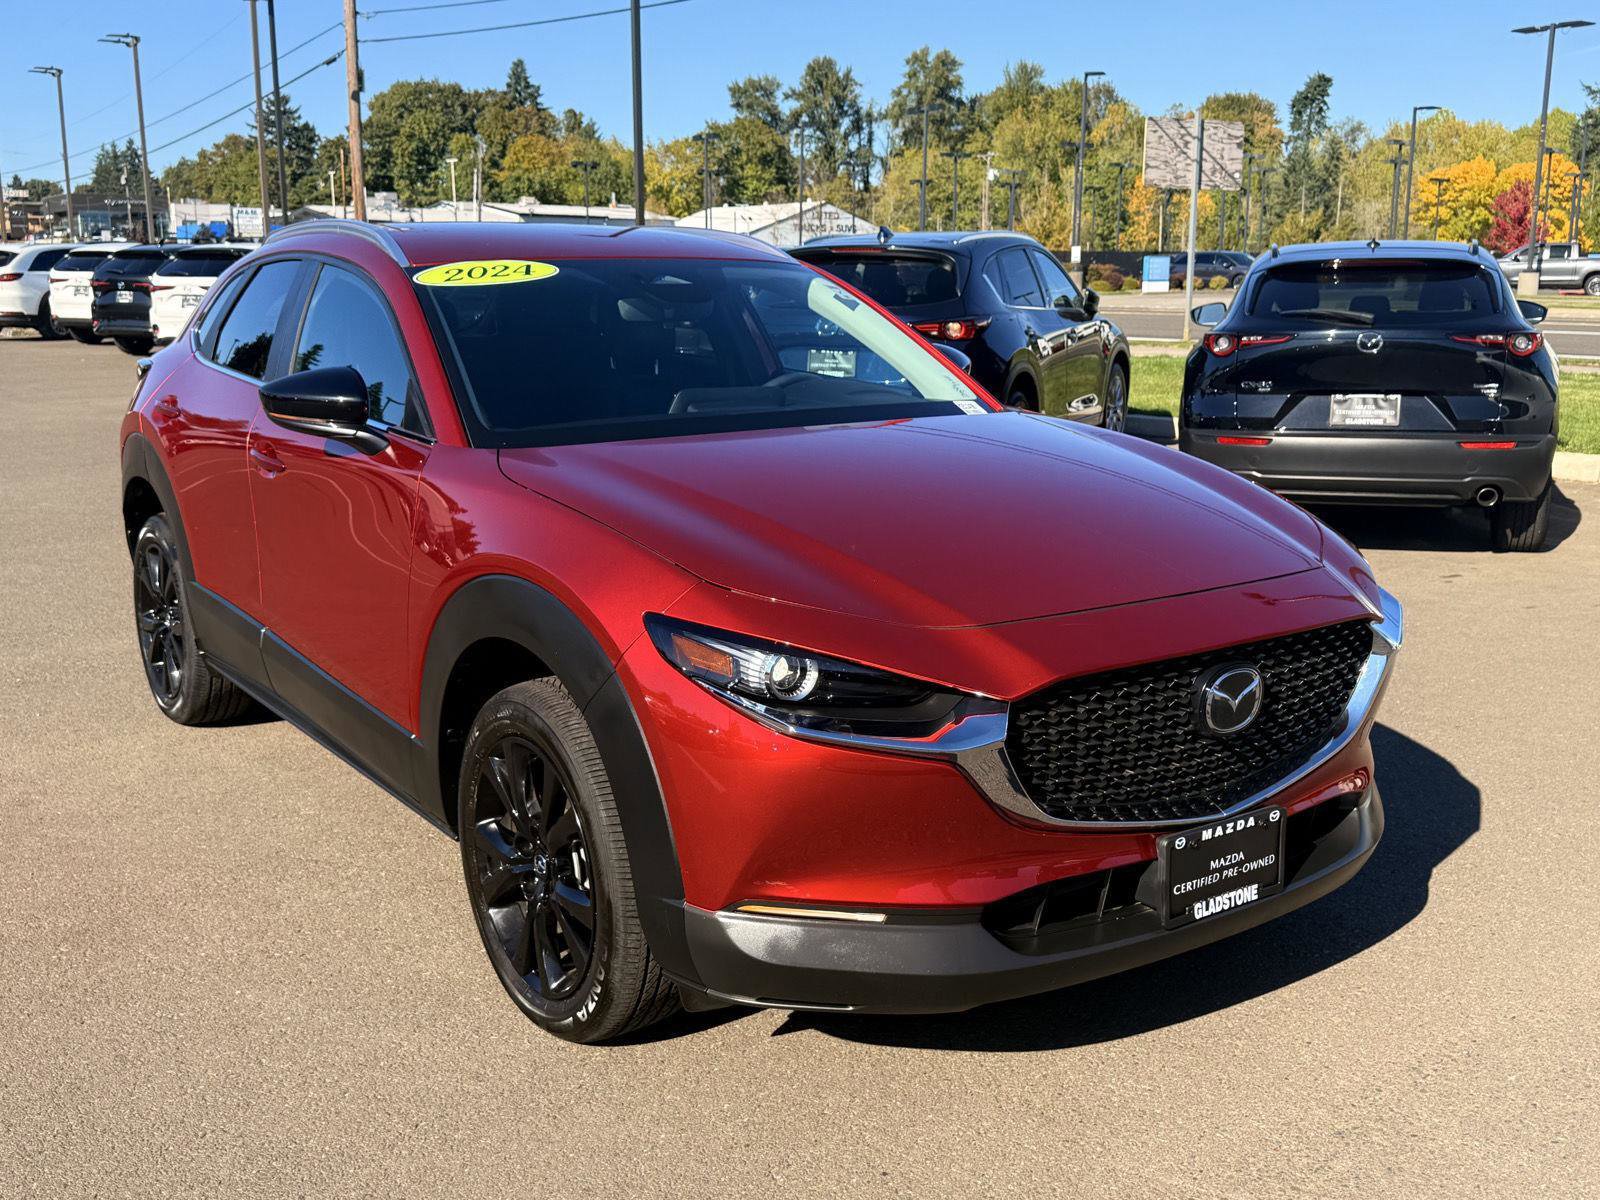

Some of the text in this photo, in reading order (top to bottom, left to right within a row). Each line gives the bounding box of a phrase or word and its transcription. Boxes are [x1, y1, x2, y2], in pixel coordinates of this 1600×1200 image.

[793, 223, 826, 232] TUCKS
[444, 264, 536, 282] 2024
[1202, 817, 1255, 841] MAZDA
[1210, 851, 1245, 870] MAZDA
[1173, 854, 1275, 895] CERTIFIED PRE-OWNED
[1194, 884, 1258, 919] GLADSTONE
